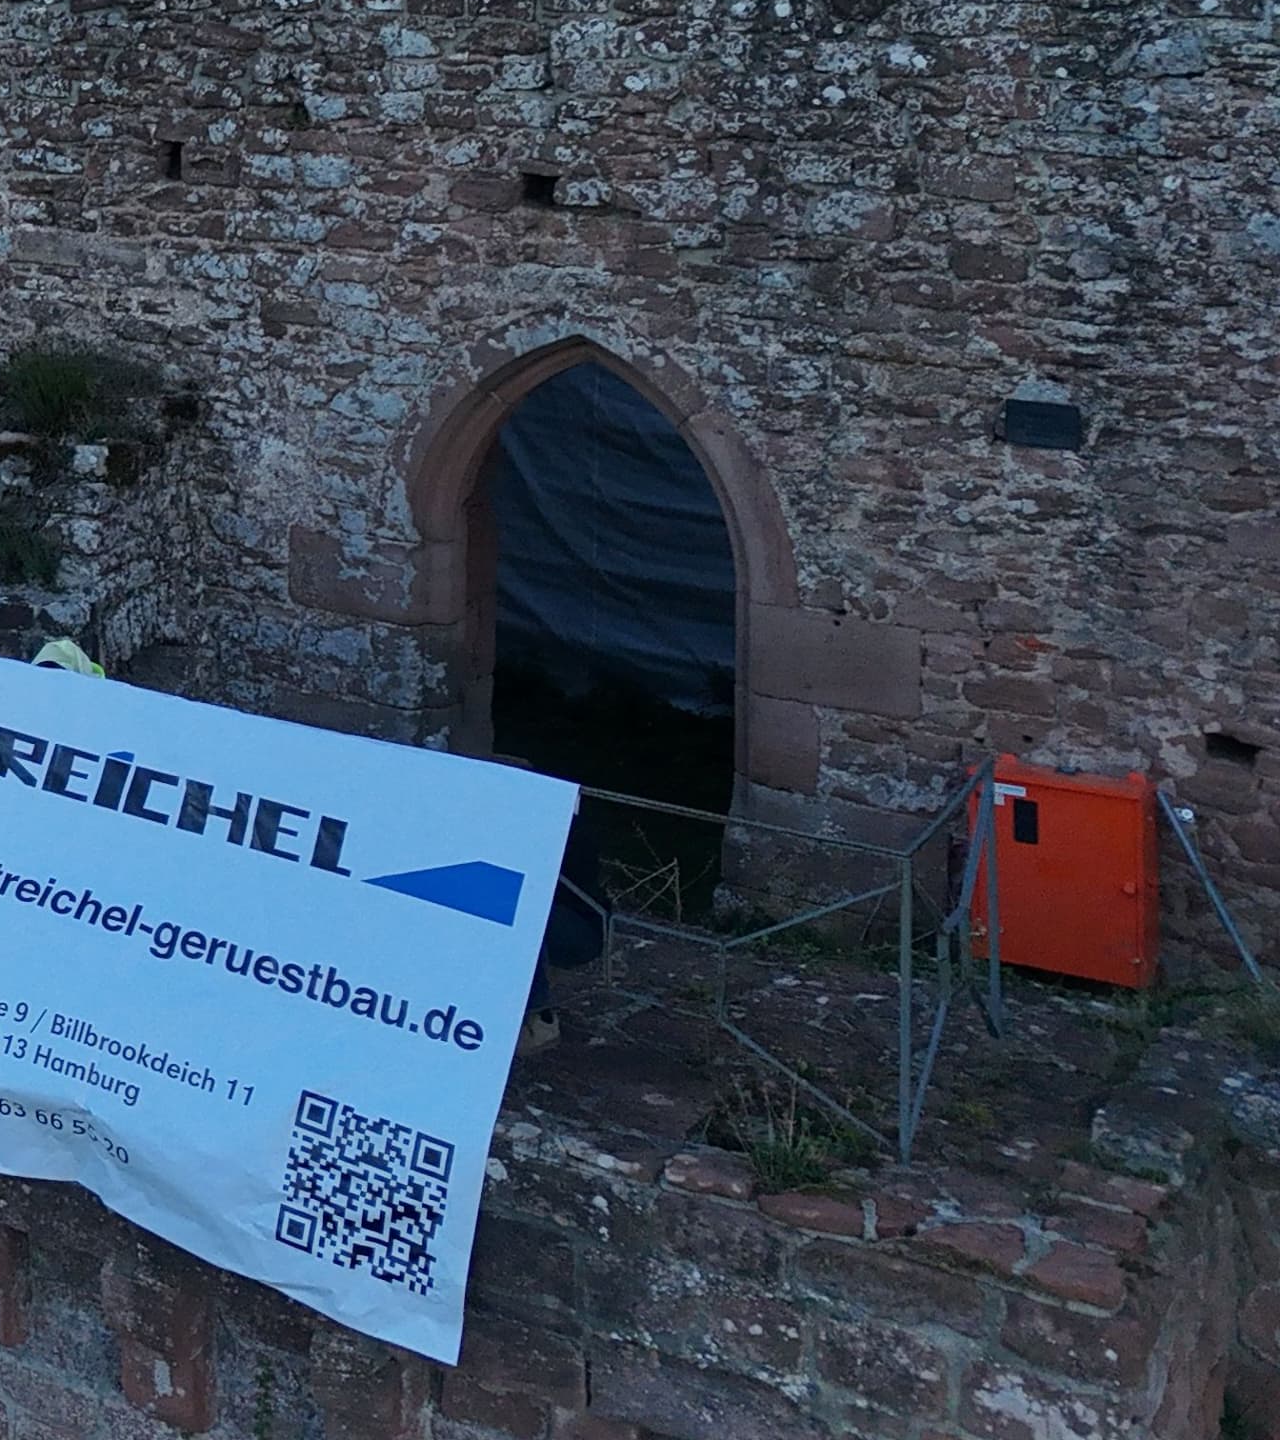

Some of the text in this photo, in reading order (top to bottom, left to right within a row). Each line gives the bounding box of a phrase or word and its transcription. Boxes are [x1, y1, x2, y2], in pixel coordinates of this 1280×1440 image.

[13, 1001, 29, 1023] 9
[30, 1009, 48, 1034] /
[50, 1013, 216, 1093] Billbrookdeich
[226, 1077, 255, 1107] 11
[33, 1044, 141, 1106] Hamburg
[35, 1109, 63, 1130] 66
